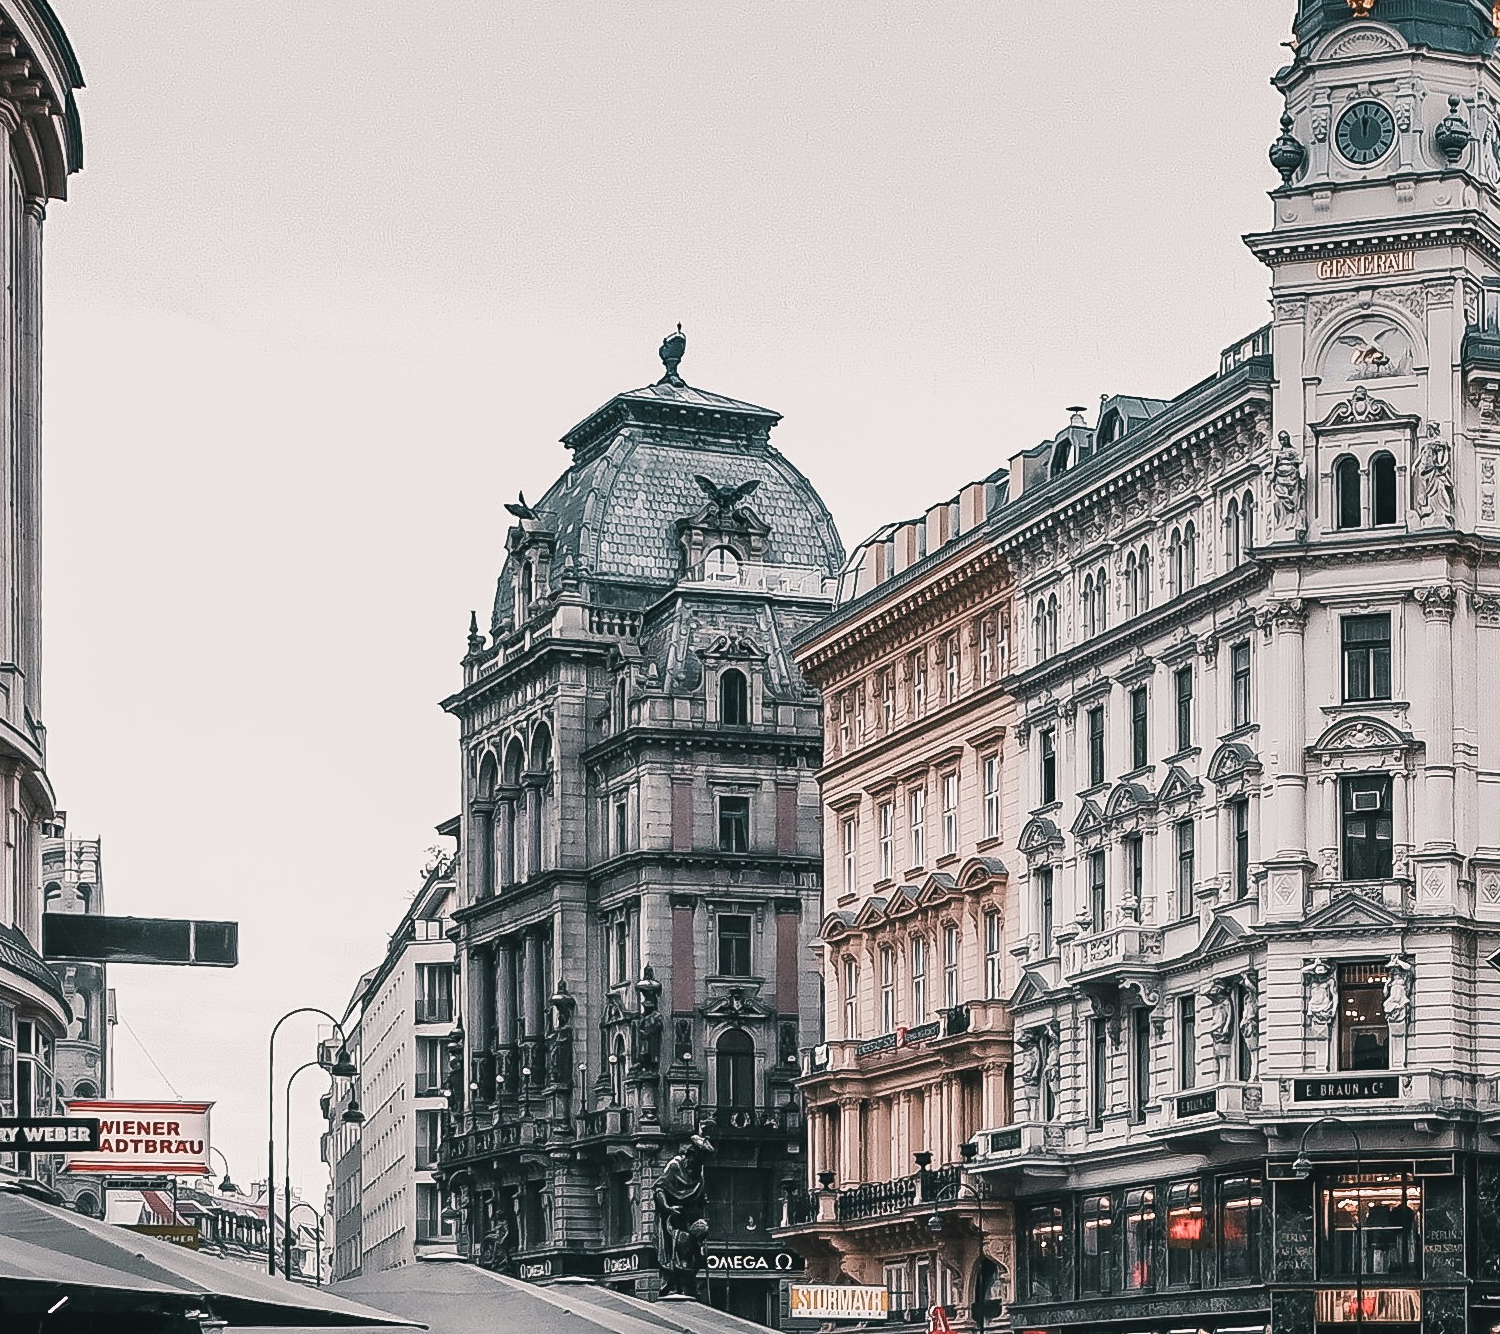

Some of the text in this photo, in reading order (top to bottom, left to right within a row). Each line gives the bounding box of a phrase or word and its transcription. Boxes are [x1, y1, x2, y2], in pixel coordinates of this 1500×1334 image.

[1320, 1083, 1359, 1096] BRAUN
[23, 1127, 91, 1143] WEBER
[99, 1120, 180, 1136] WIENER
[99, 1138, 204, 1155] ADTBRÄU
[152, 1233, 194, 1245] OCHER
[707, 1255, 768, 1269] OMEGA
[798, 1288, 882, 1312] STURMAYR
